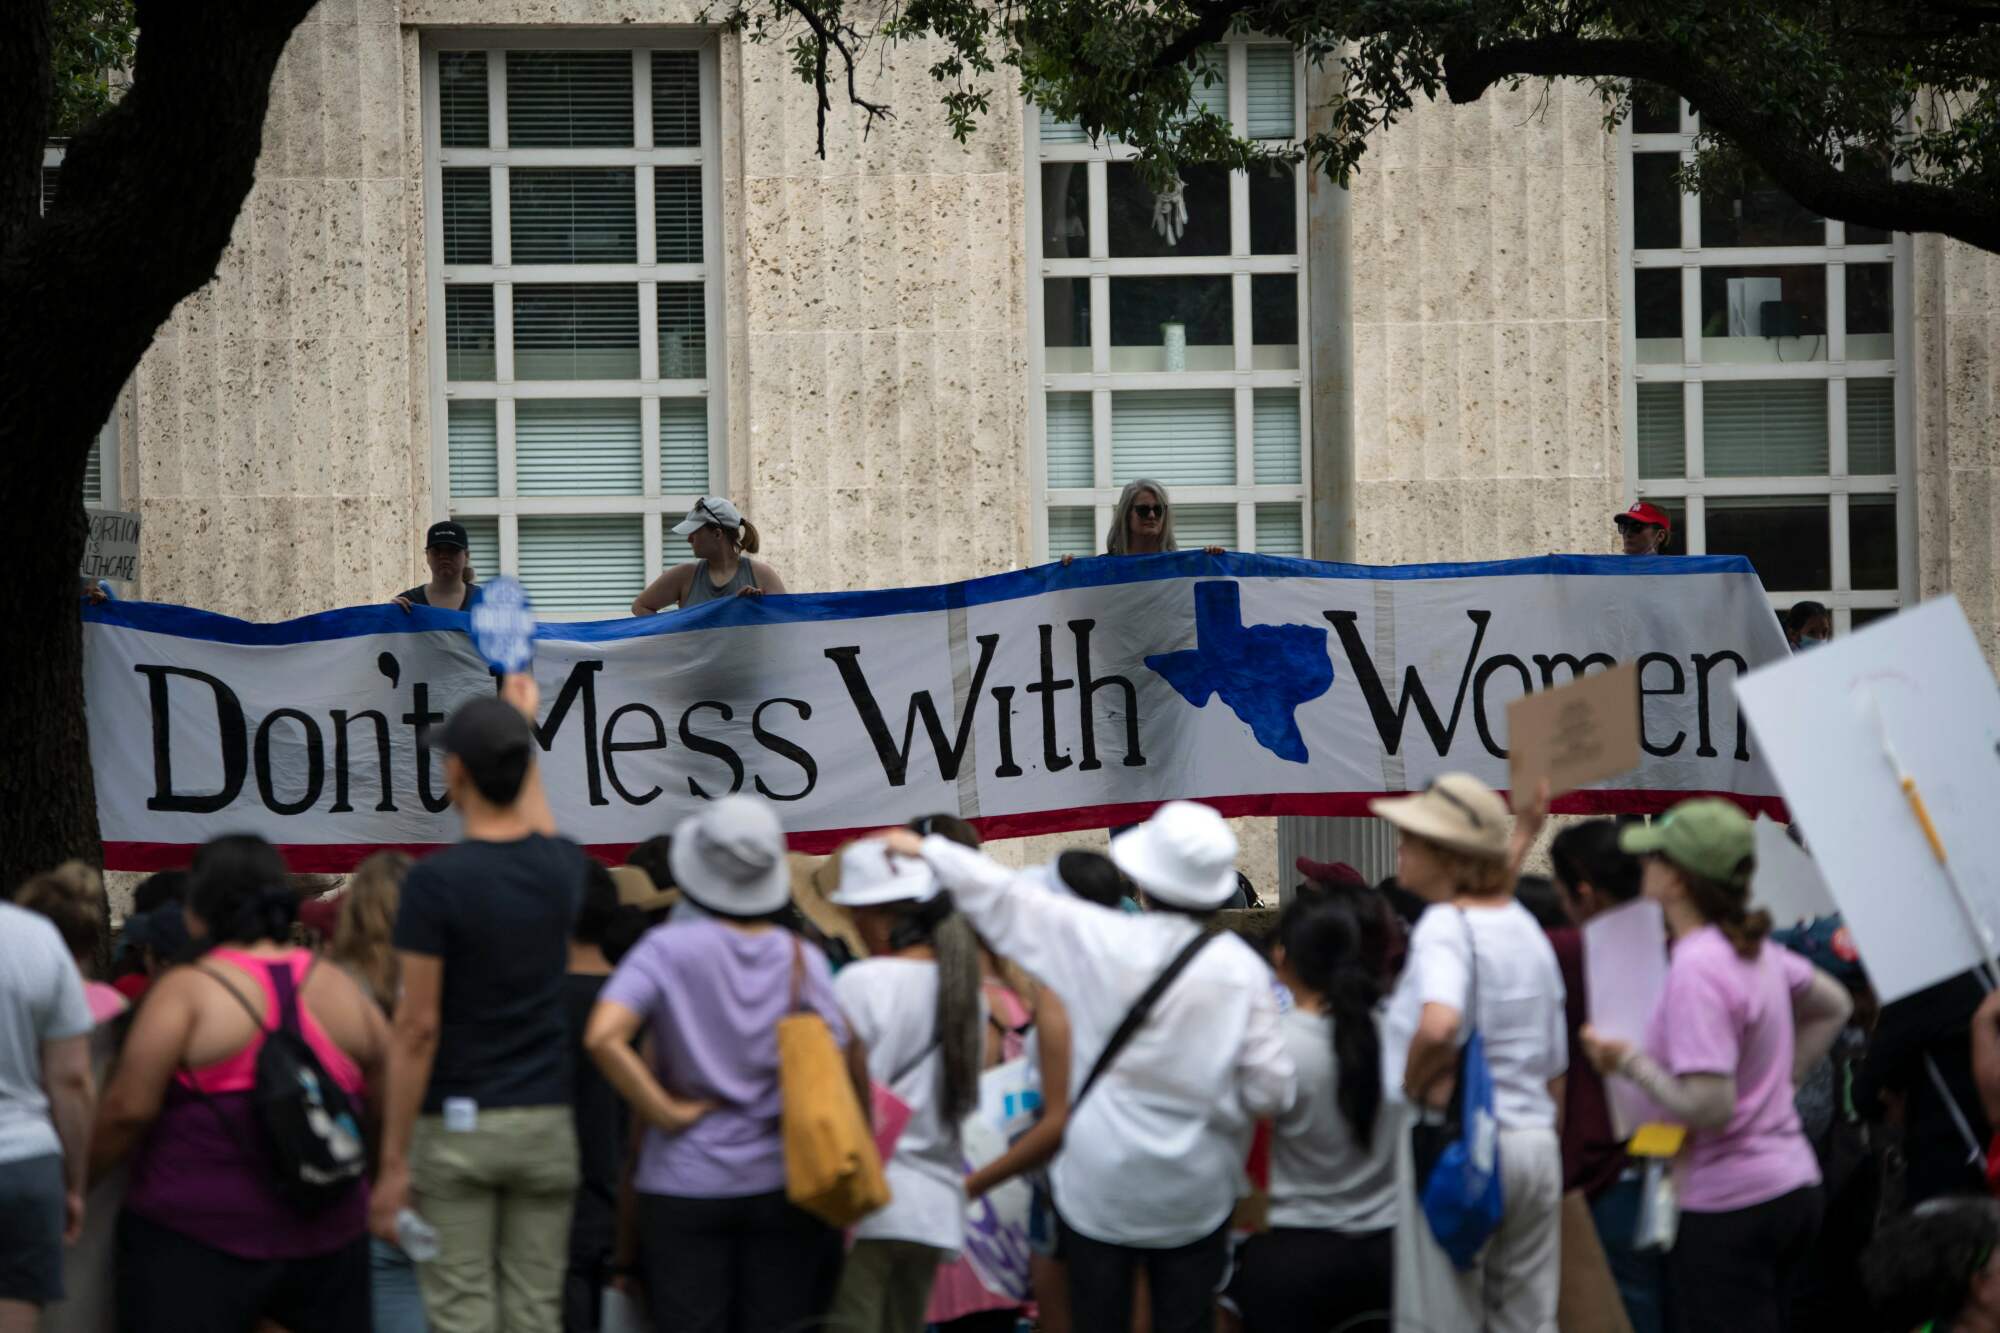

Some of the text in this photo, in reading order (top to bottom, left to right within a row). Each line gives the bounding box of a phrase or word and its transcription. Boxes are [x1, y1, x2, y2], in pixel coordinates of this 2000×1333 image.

[88, 515, 139, 544] ORTION
[80, 555, 136, 580] ALTHCARE
[134, 651, 451, 813] Don't
[824, 618, 1147, 786] With
